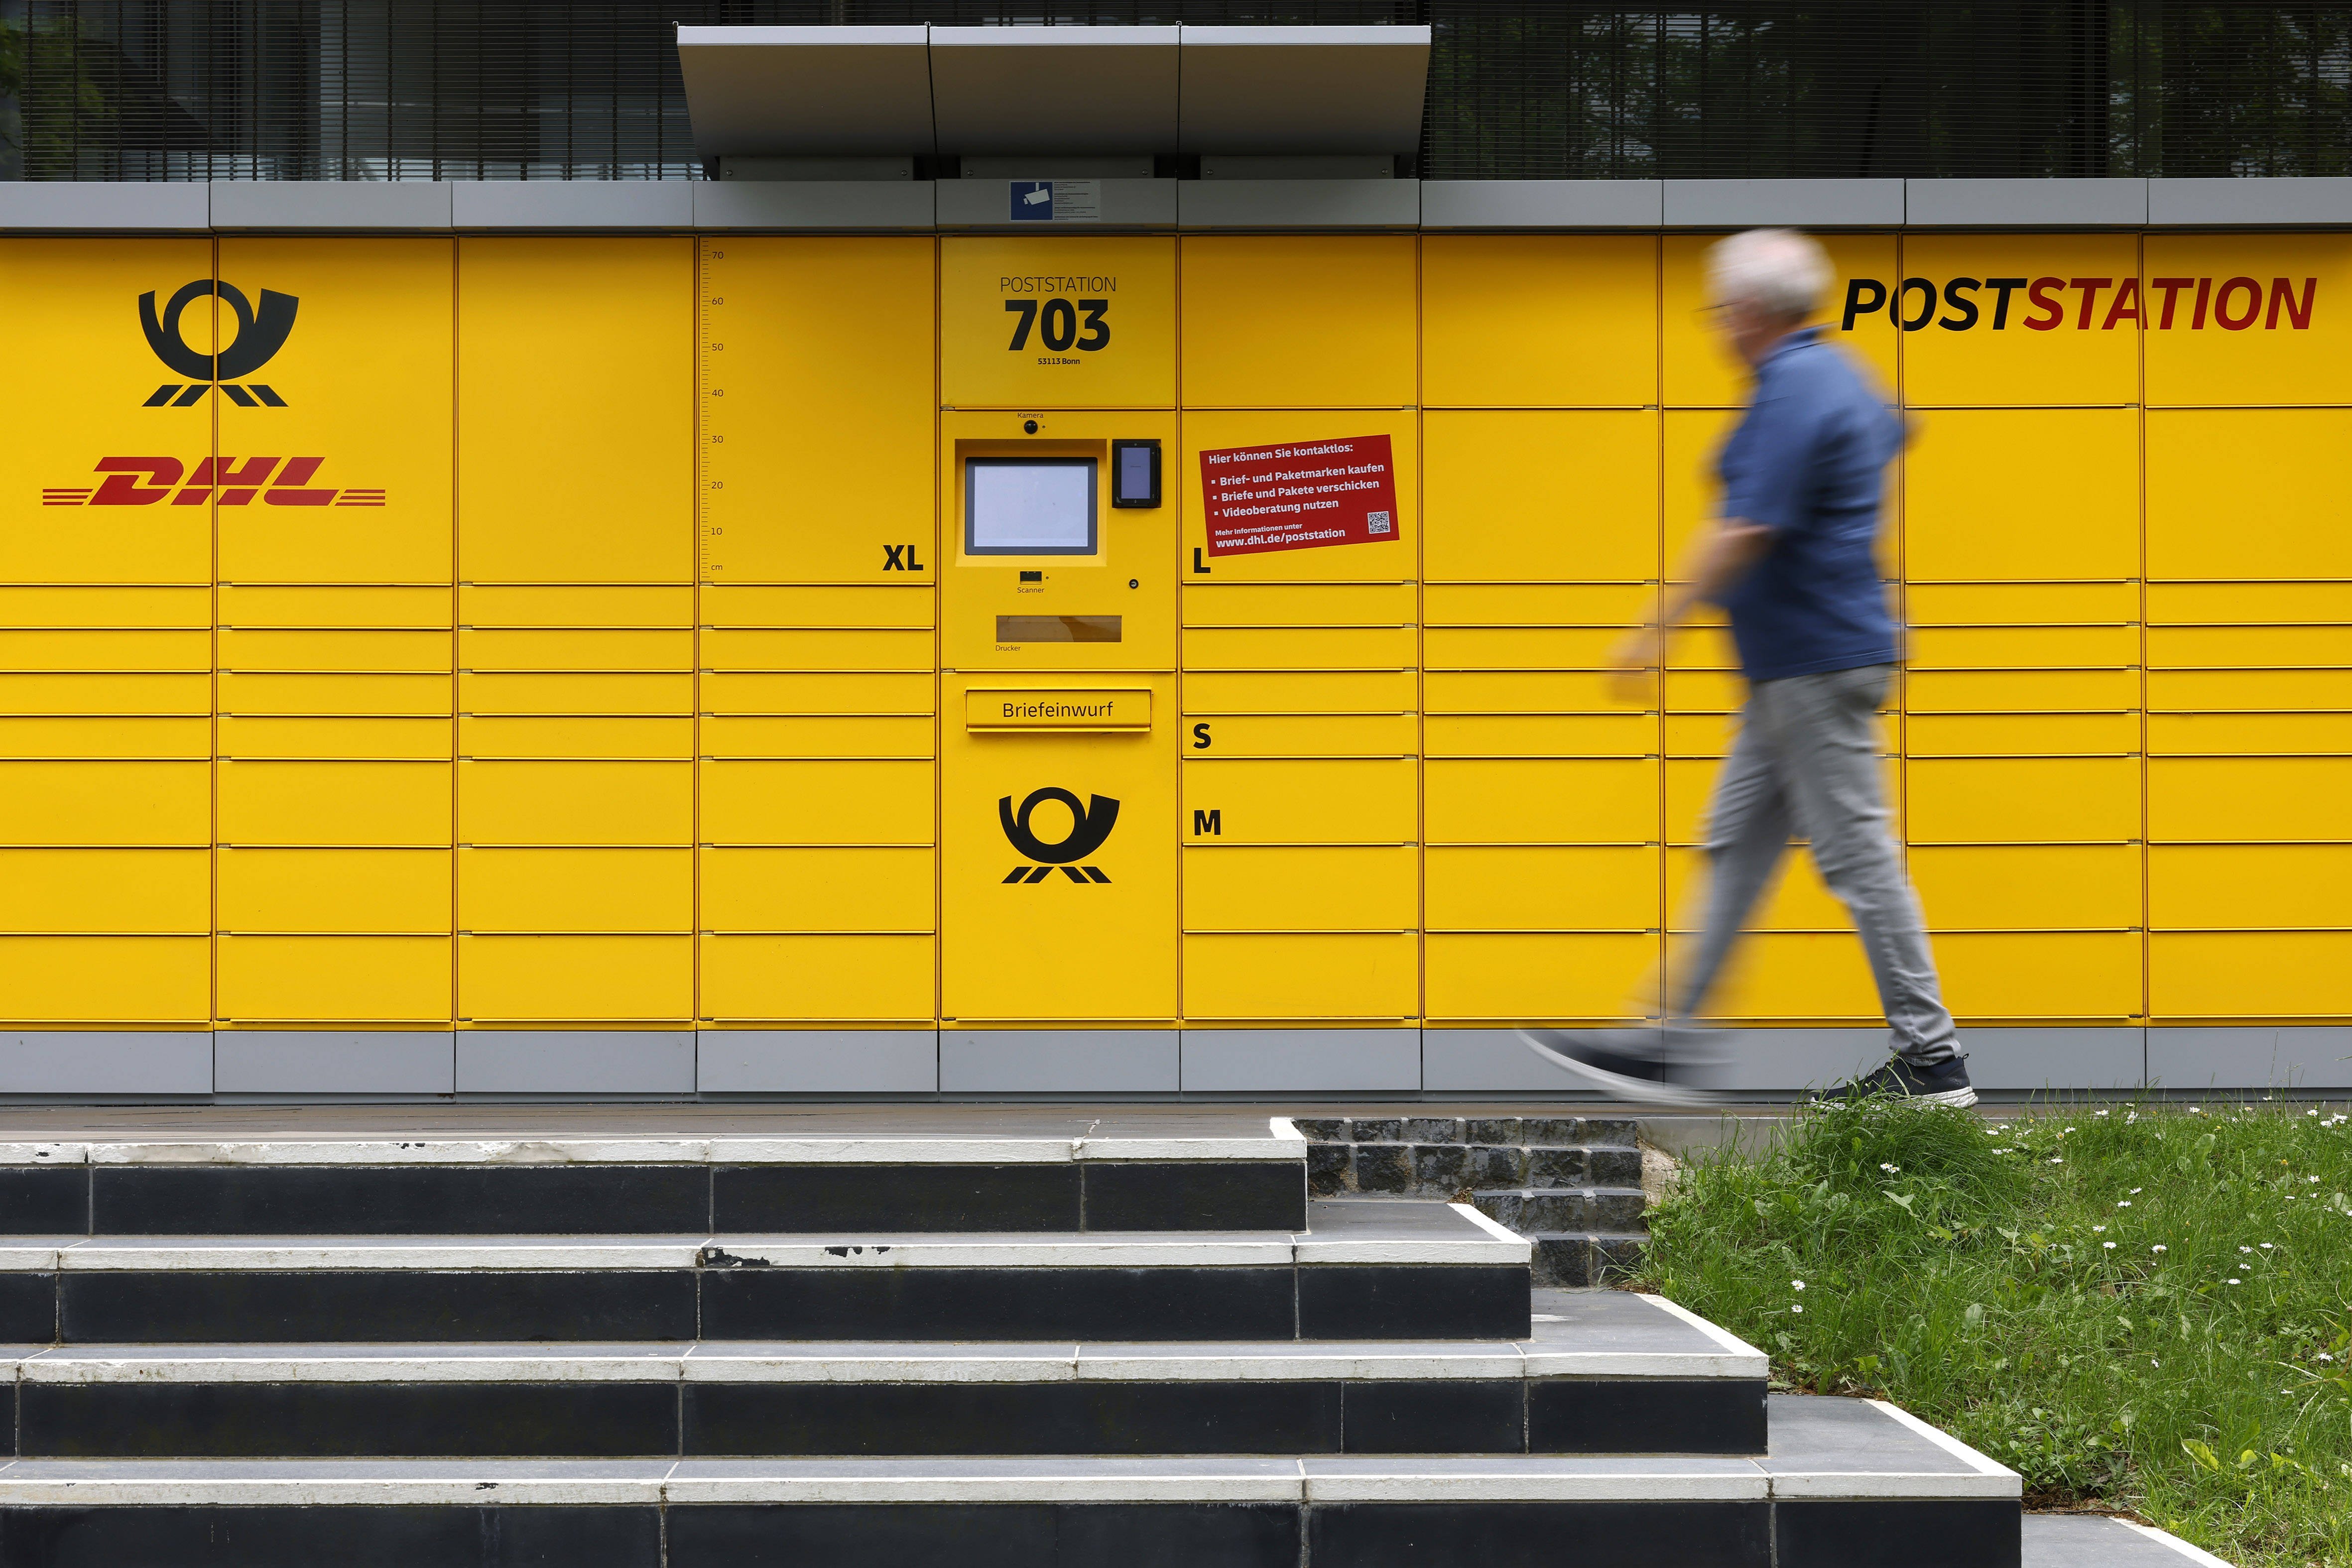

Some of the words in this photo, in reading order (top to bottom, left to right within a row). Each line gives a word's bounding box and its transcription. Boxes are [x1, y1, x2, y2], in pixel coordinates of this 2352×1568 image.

[712, 251, 724, 259] 70
[1000, 276, 1116, 292] POSTSTATION
[1841, 276, 2318, 333] POSTSTATION
[1005, 298, 1111, 352] 703
[1209, 454, 1232, 464] Hier
[1233, 452, 1273, 462] können
[1275, 448, 1291, 458] Sie
[1293, 444, 1354, 457] kontaktlos:
[88, 456, 340, 506] DHL
[1220, 475, 1250, 486] Brief-
[1252, 472, 1273, 483] und
[1275, 467, 1346, 481] Paketmarken
[1348, 463, 1384, 475] kaufen
[1221, 490, 1253, 501] Briefe
[1255, 487, 1276, 498] und
[1278, 486, 1314, 496] Pakete
[1316, 480, 1379, 493] verschicken
[1222, 503, 1301, 517] Videoberatung
[1303, 500, 1339, 510] nutzen
[1216, 528, 1346, 548] www.dhl.de/poststation
[1234, 524, 1283, 534] Informationen
[882, 545, 924, 571] XL
[1194, 547, 1211, 574] L
[1003, 701, 1114, 718] Briefeinwurf
[1193, 723, 1212, 749] S
[1194, 809, 1221, 836] M
